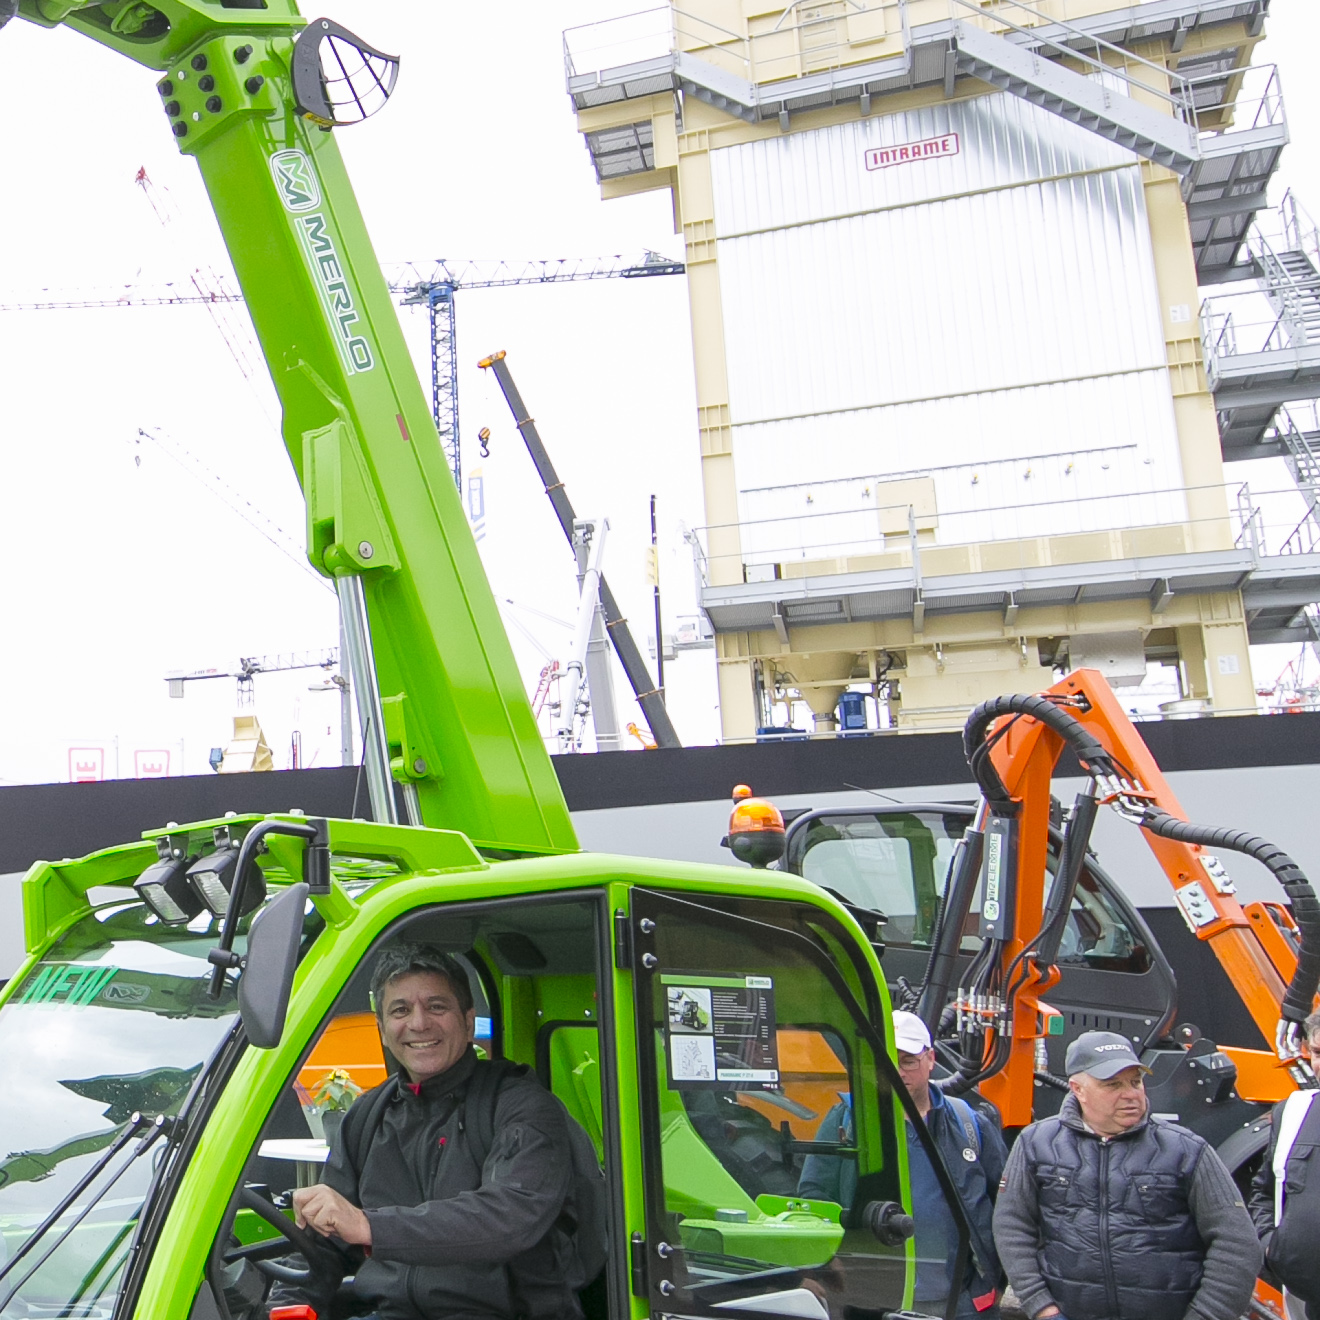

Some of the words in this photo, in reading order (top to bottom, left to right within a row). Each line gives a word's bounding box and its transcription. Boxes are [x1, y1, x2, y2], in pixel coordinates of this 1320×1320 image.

[873, 138, 950, 165] INTRAME
[304, 213, 376, 373] MERLO
[16, 966, 120, 1012] NEW
